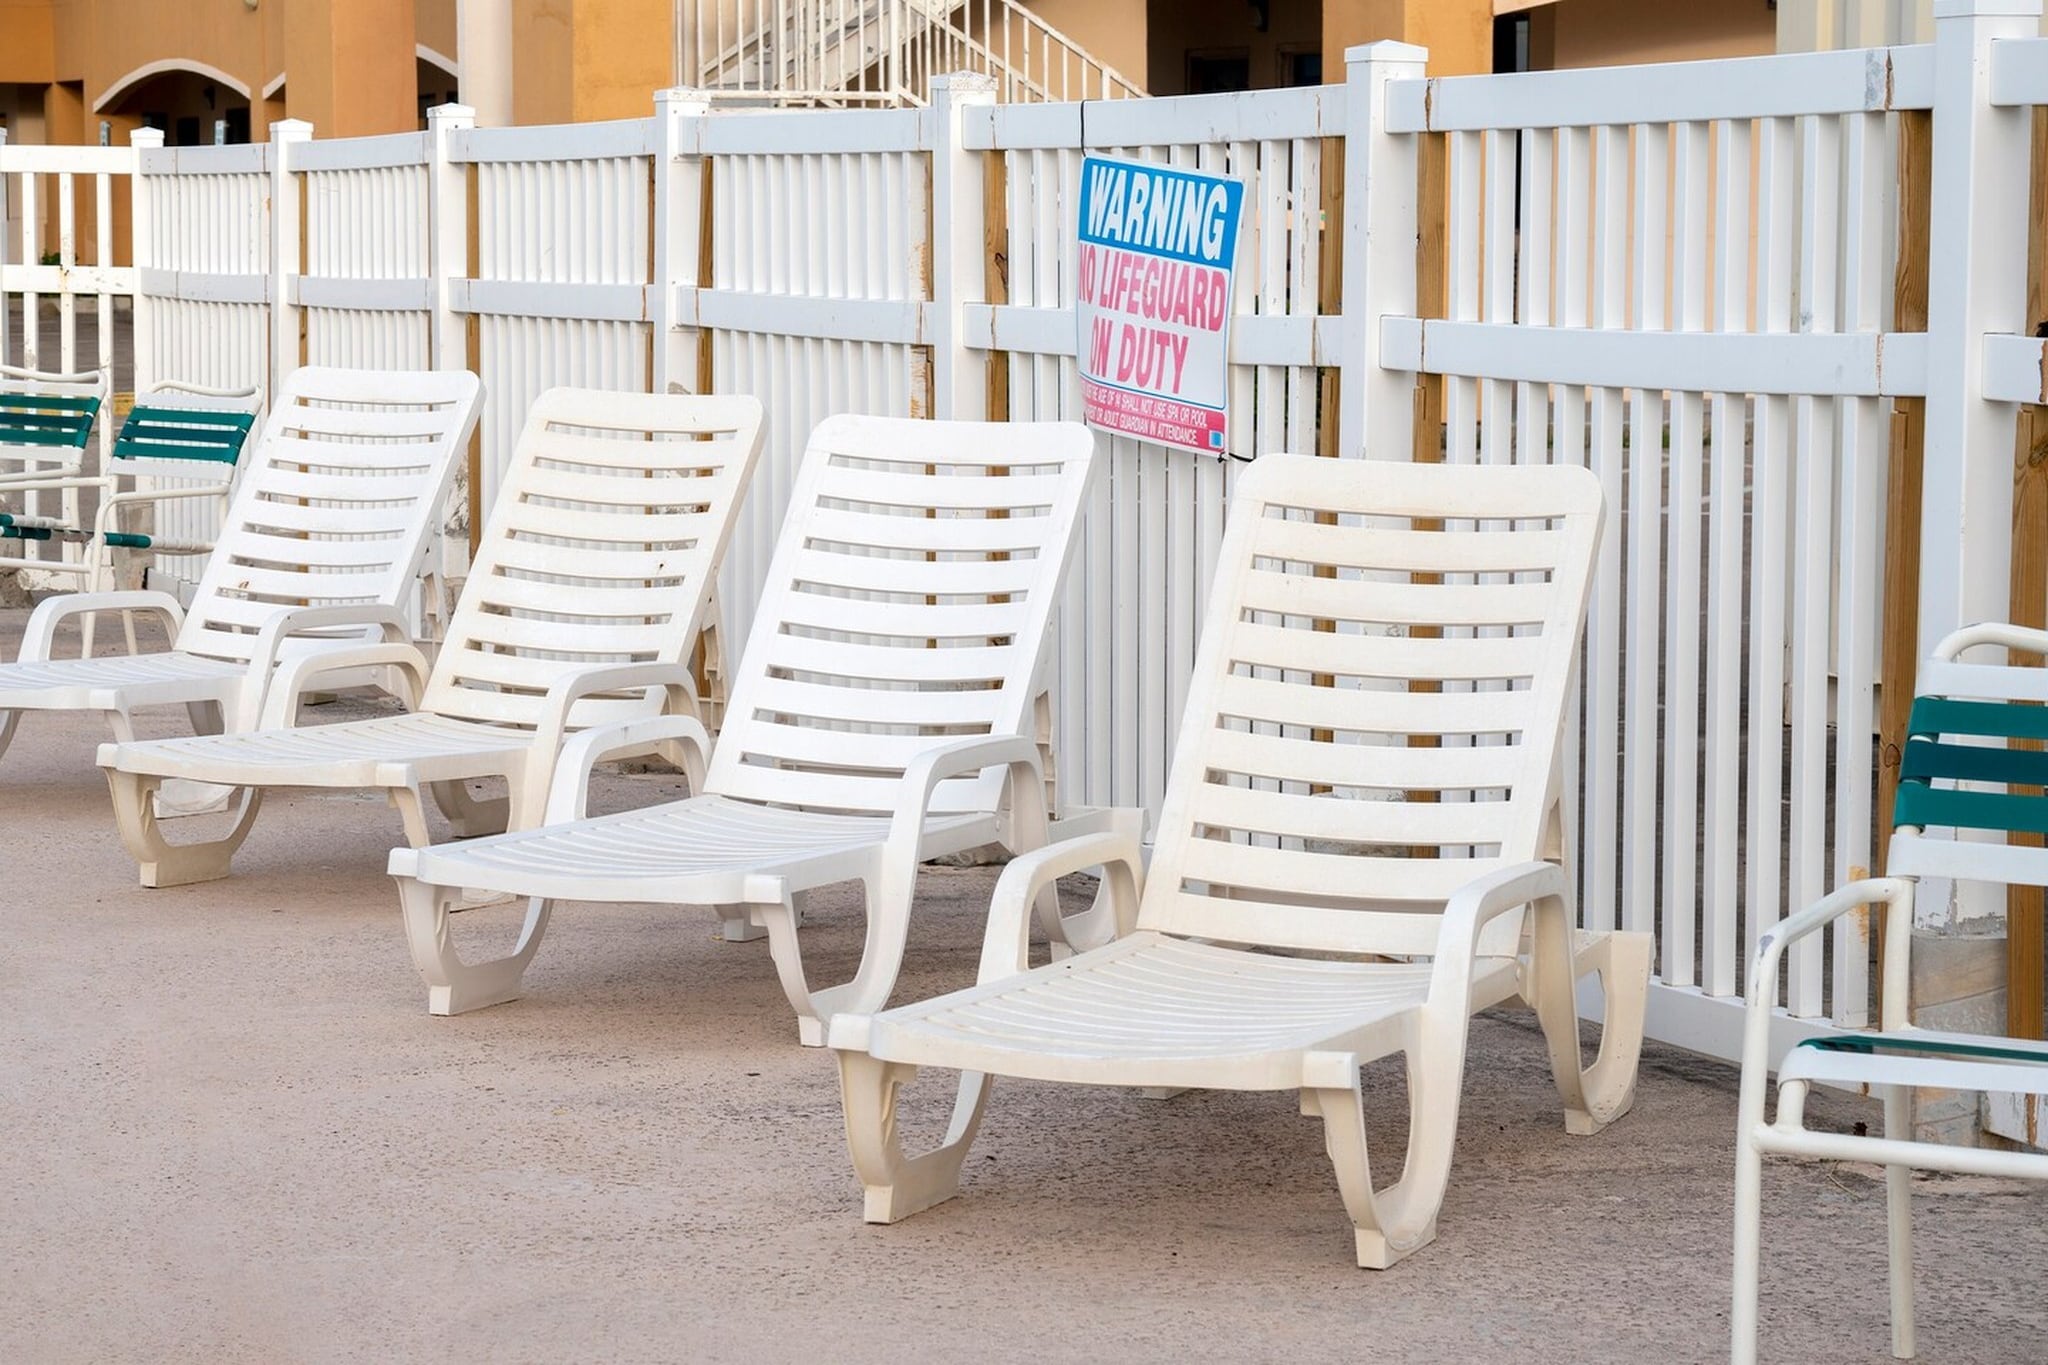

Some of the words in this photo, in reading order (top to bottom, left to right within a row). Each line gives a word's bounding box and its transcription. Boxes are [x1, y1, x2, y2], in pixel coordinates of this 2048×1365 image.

[1087, 165, 1228, 261] WARNING
[1078, 242, 1096, 304] NO
[1099, 250, 1226, 331] LIFEGUARD
[1089, 315, 1113, 378] ON
[1116, 324, 1189, 394] DUTY
[1104, 410, 1119, 426] ADULT
[1119, 413, 1149, 435] GUARDIAN
[1150, 420, 1157, 436] IN
[1121, 394, 1139, 411] SHALL
[1141, 399, 1154, 414] NOT
[1153, 402, 1166, 418] USE
[1167, 404, 1179, 420] SPA
[1180, 407, 1191, 424] OR
[1191, 409, 1207, 427] POOL
